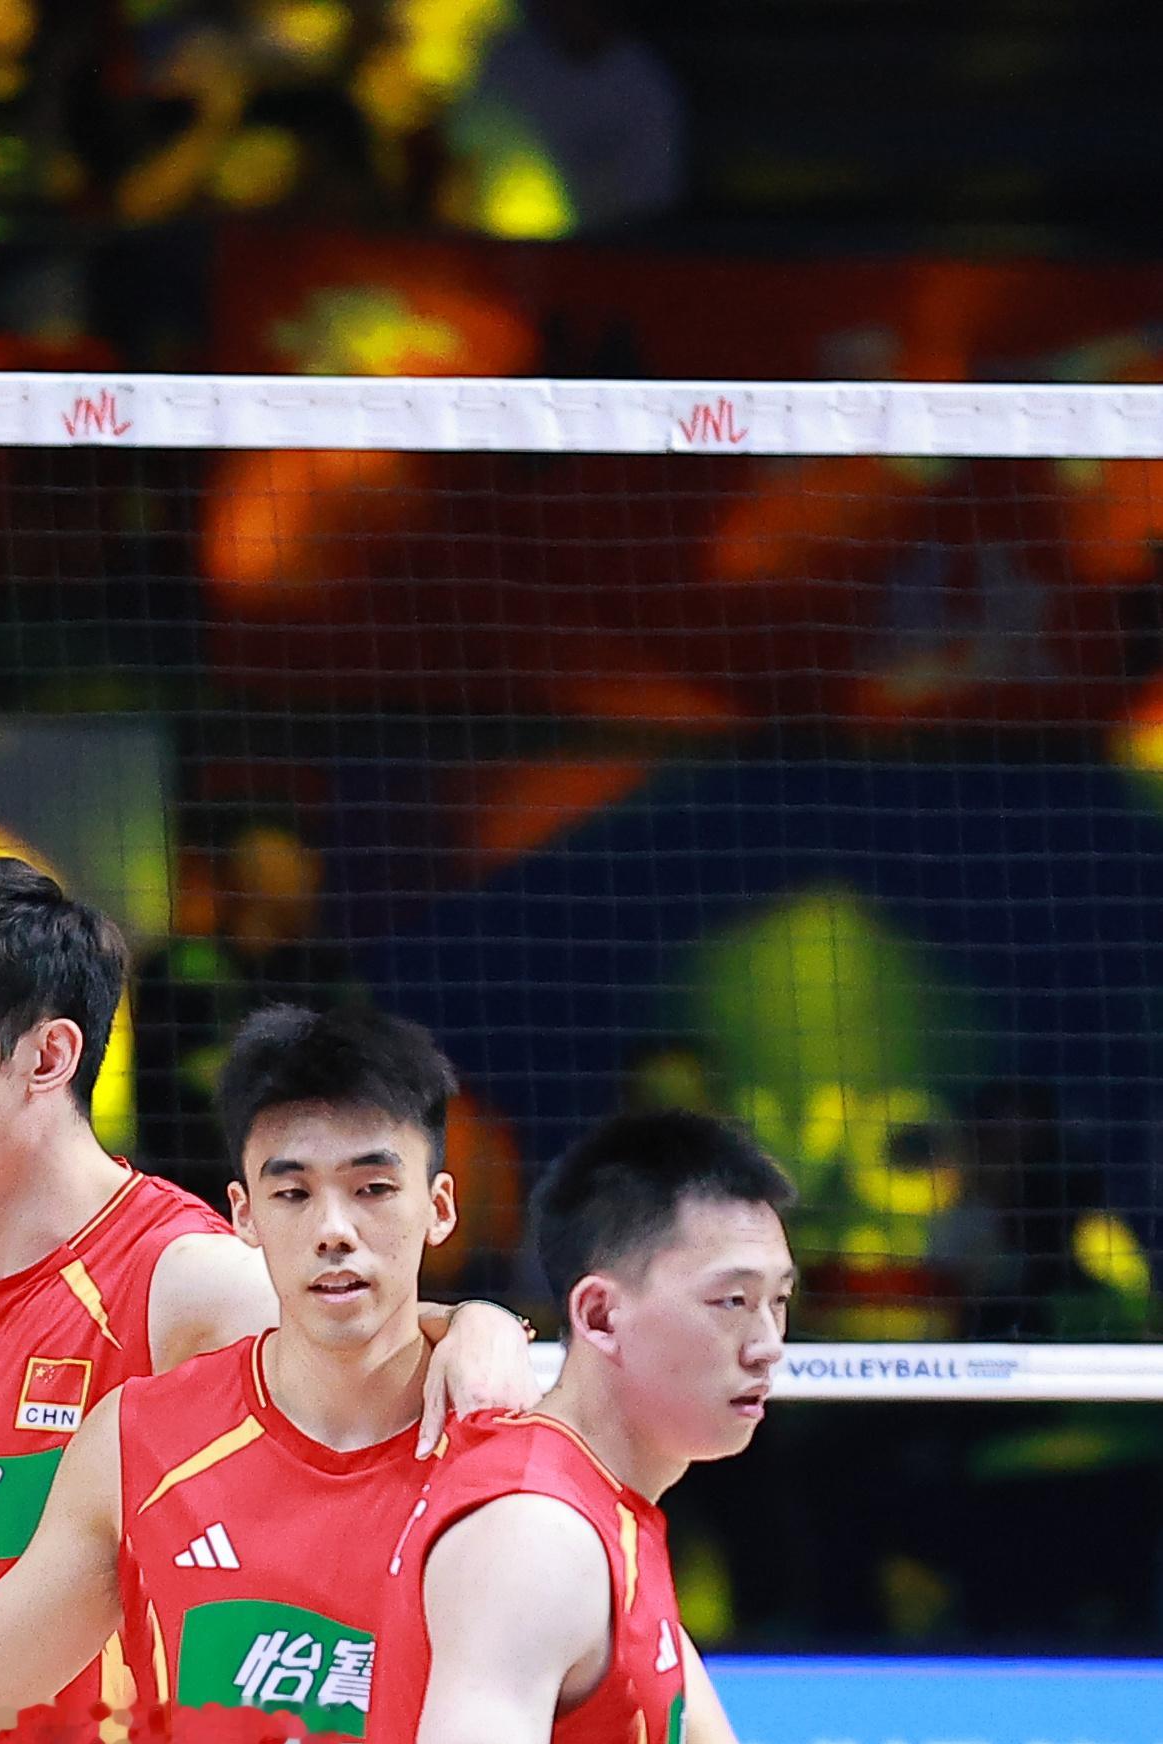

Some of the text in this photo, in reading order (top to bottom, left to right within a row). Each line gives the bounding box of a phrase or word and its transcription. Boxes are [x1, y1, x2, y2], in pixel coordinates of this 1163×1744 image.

[61, 388, 133, 436] VNL
[678, 395, 750, 443] VNL
[789, 1359, 959, 1378] VOLLEYBALL
[26, 1407, 75, 1425] CHN
